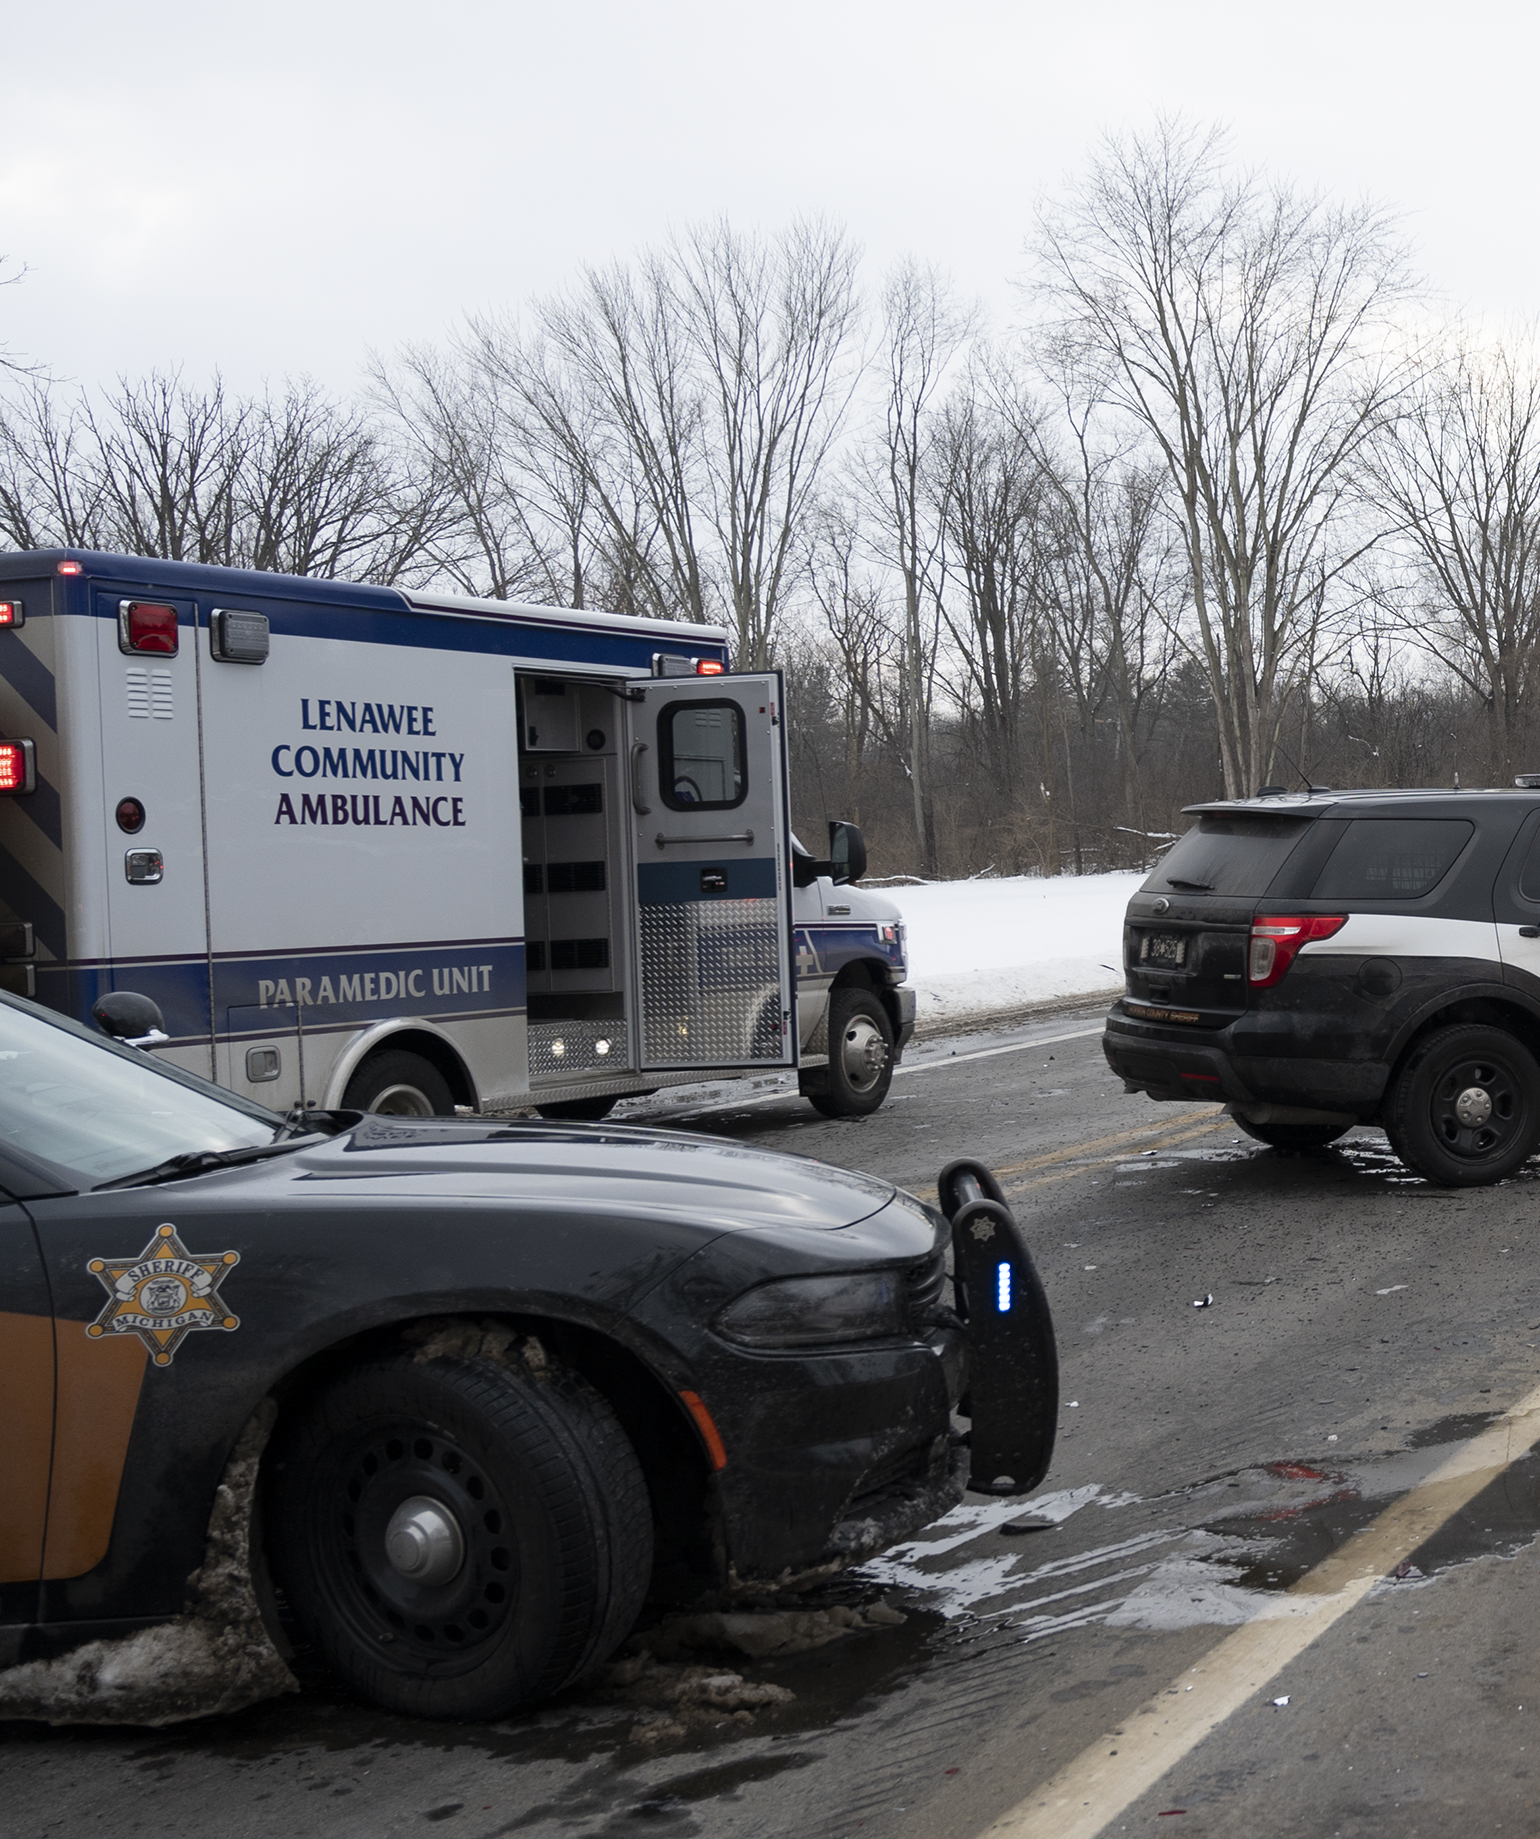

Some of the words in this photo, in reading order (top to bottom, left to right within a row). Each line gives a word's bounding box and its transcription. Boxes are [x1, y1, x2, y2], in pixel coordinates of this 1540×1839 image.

[301, 698, 437, 736] LENAWEE
[271, 744, 465, 782] COMMUNITY
[274, 793, 467, 827] AMBULANCE
[258, 969, 426, 1009] PARAMEDIC
[432, 965, 493, 996] UNIT
[127, 1260, 204, 1282] SHERIFF
[115, 1312, 213, 1327] MICHIGAN
